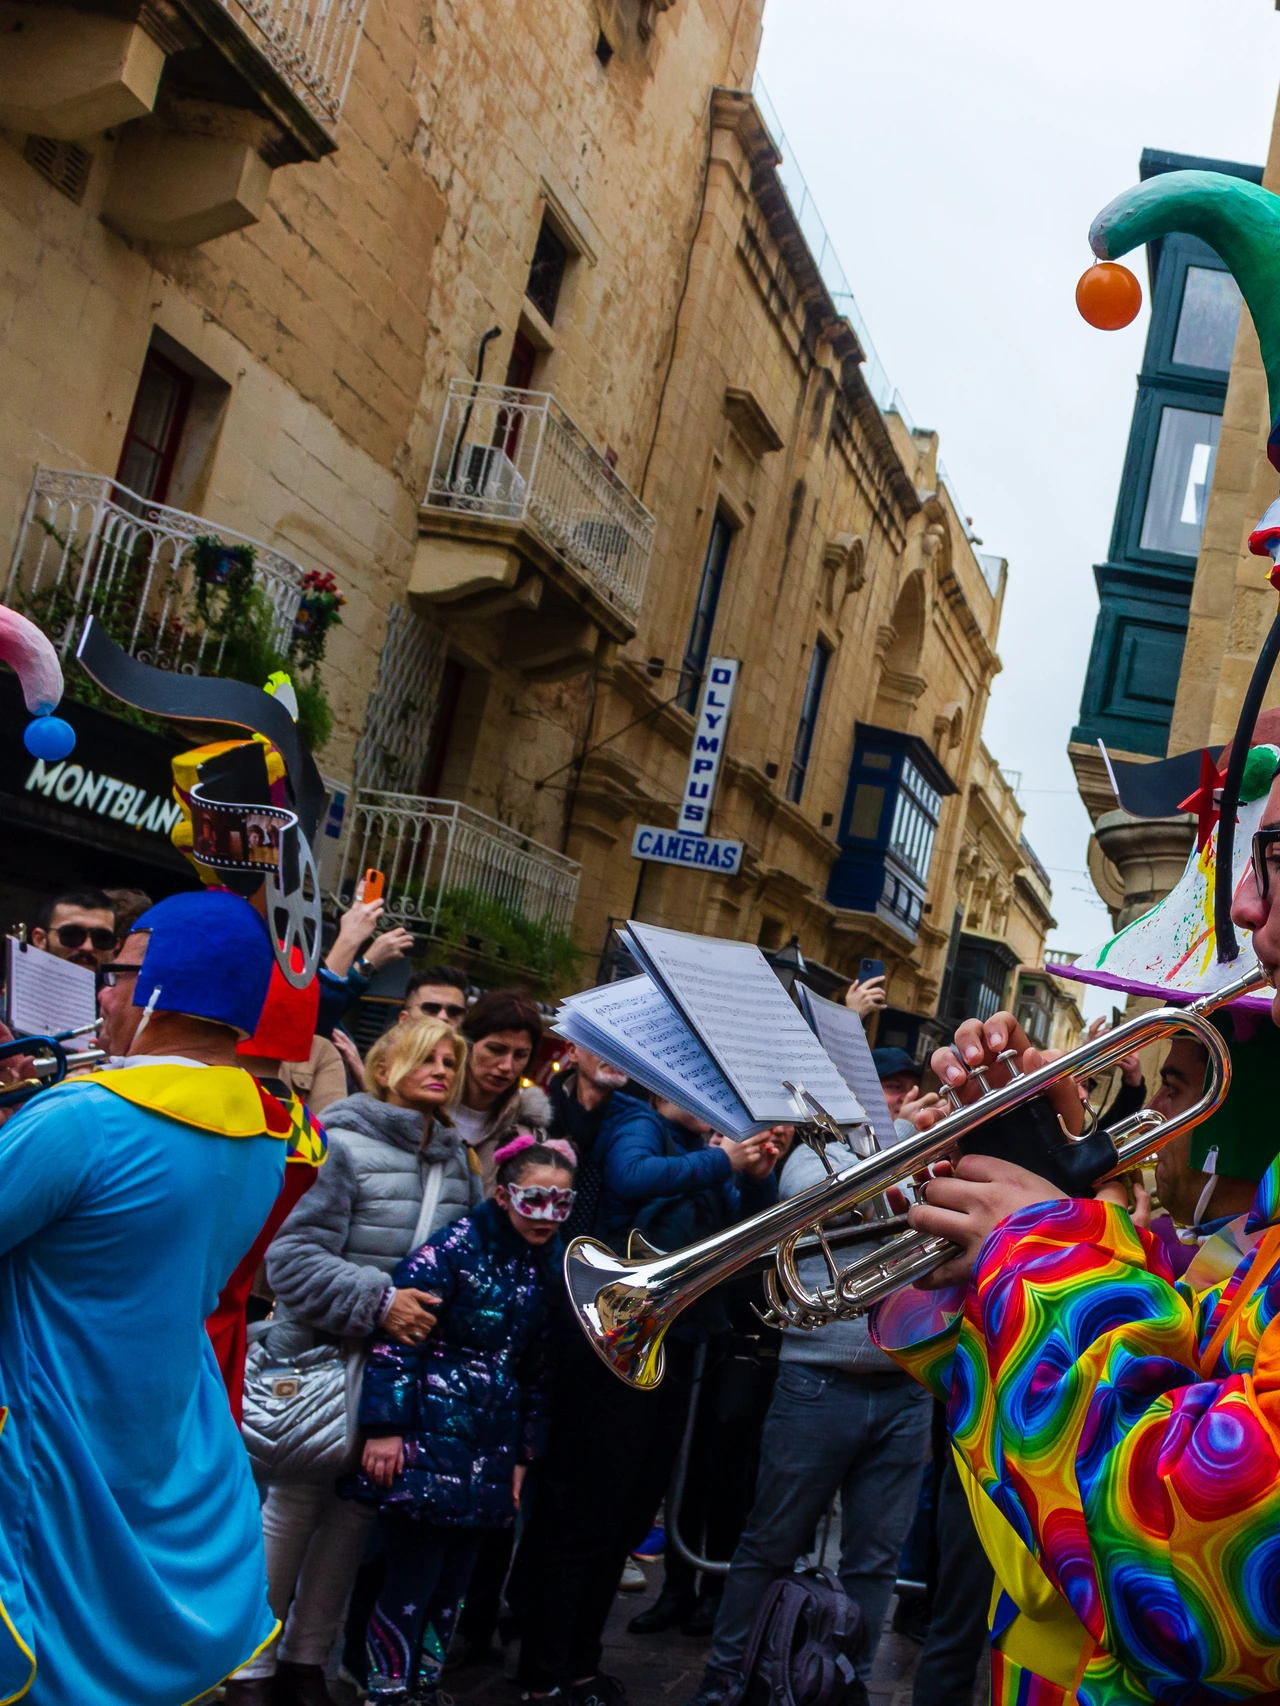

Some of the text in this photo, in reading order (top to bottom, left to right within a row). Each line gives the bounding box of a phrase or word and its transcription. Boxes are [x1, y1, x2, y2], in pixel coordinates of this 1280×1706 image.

[684, 668, 732, 821] OLYMPUS
[25, 758, 184, 834] MONTBLAN
[637, 831, 737, 869] CAMERAS
